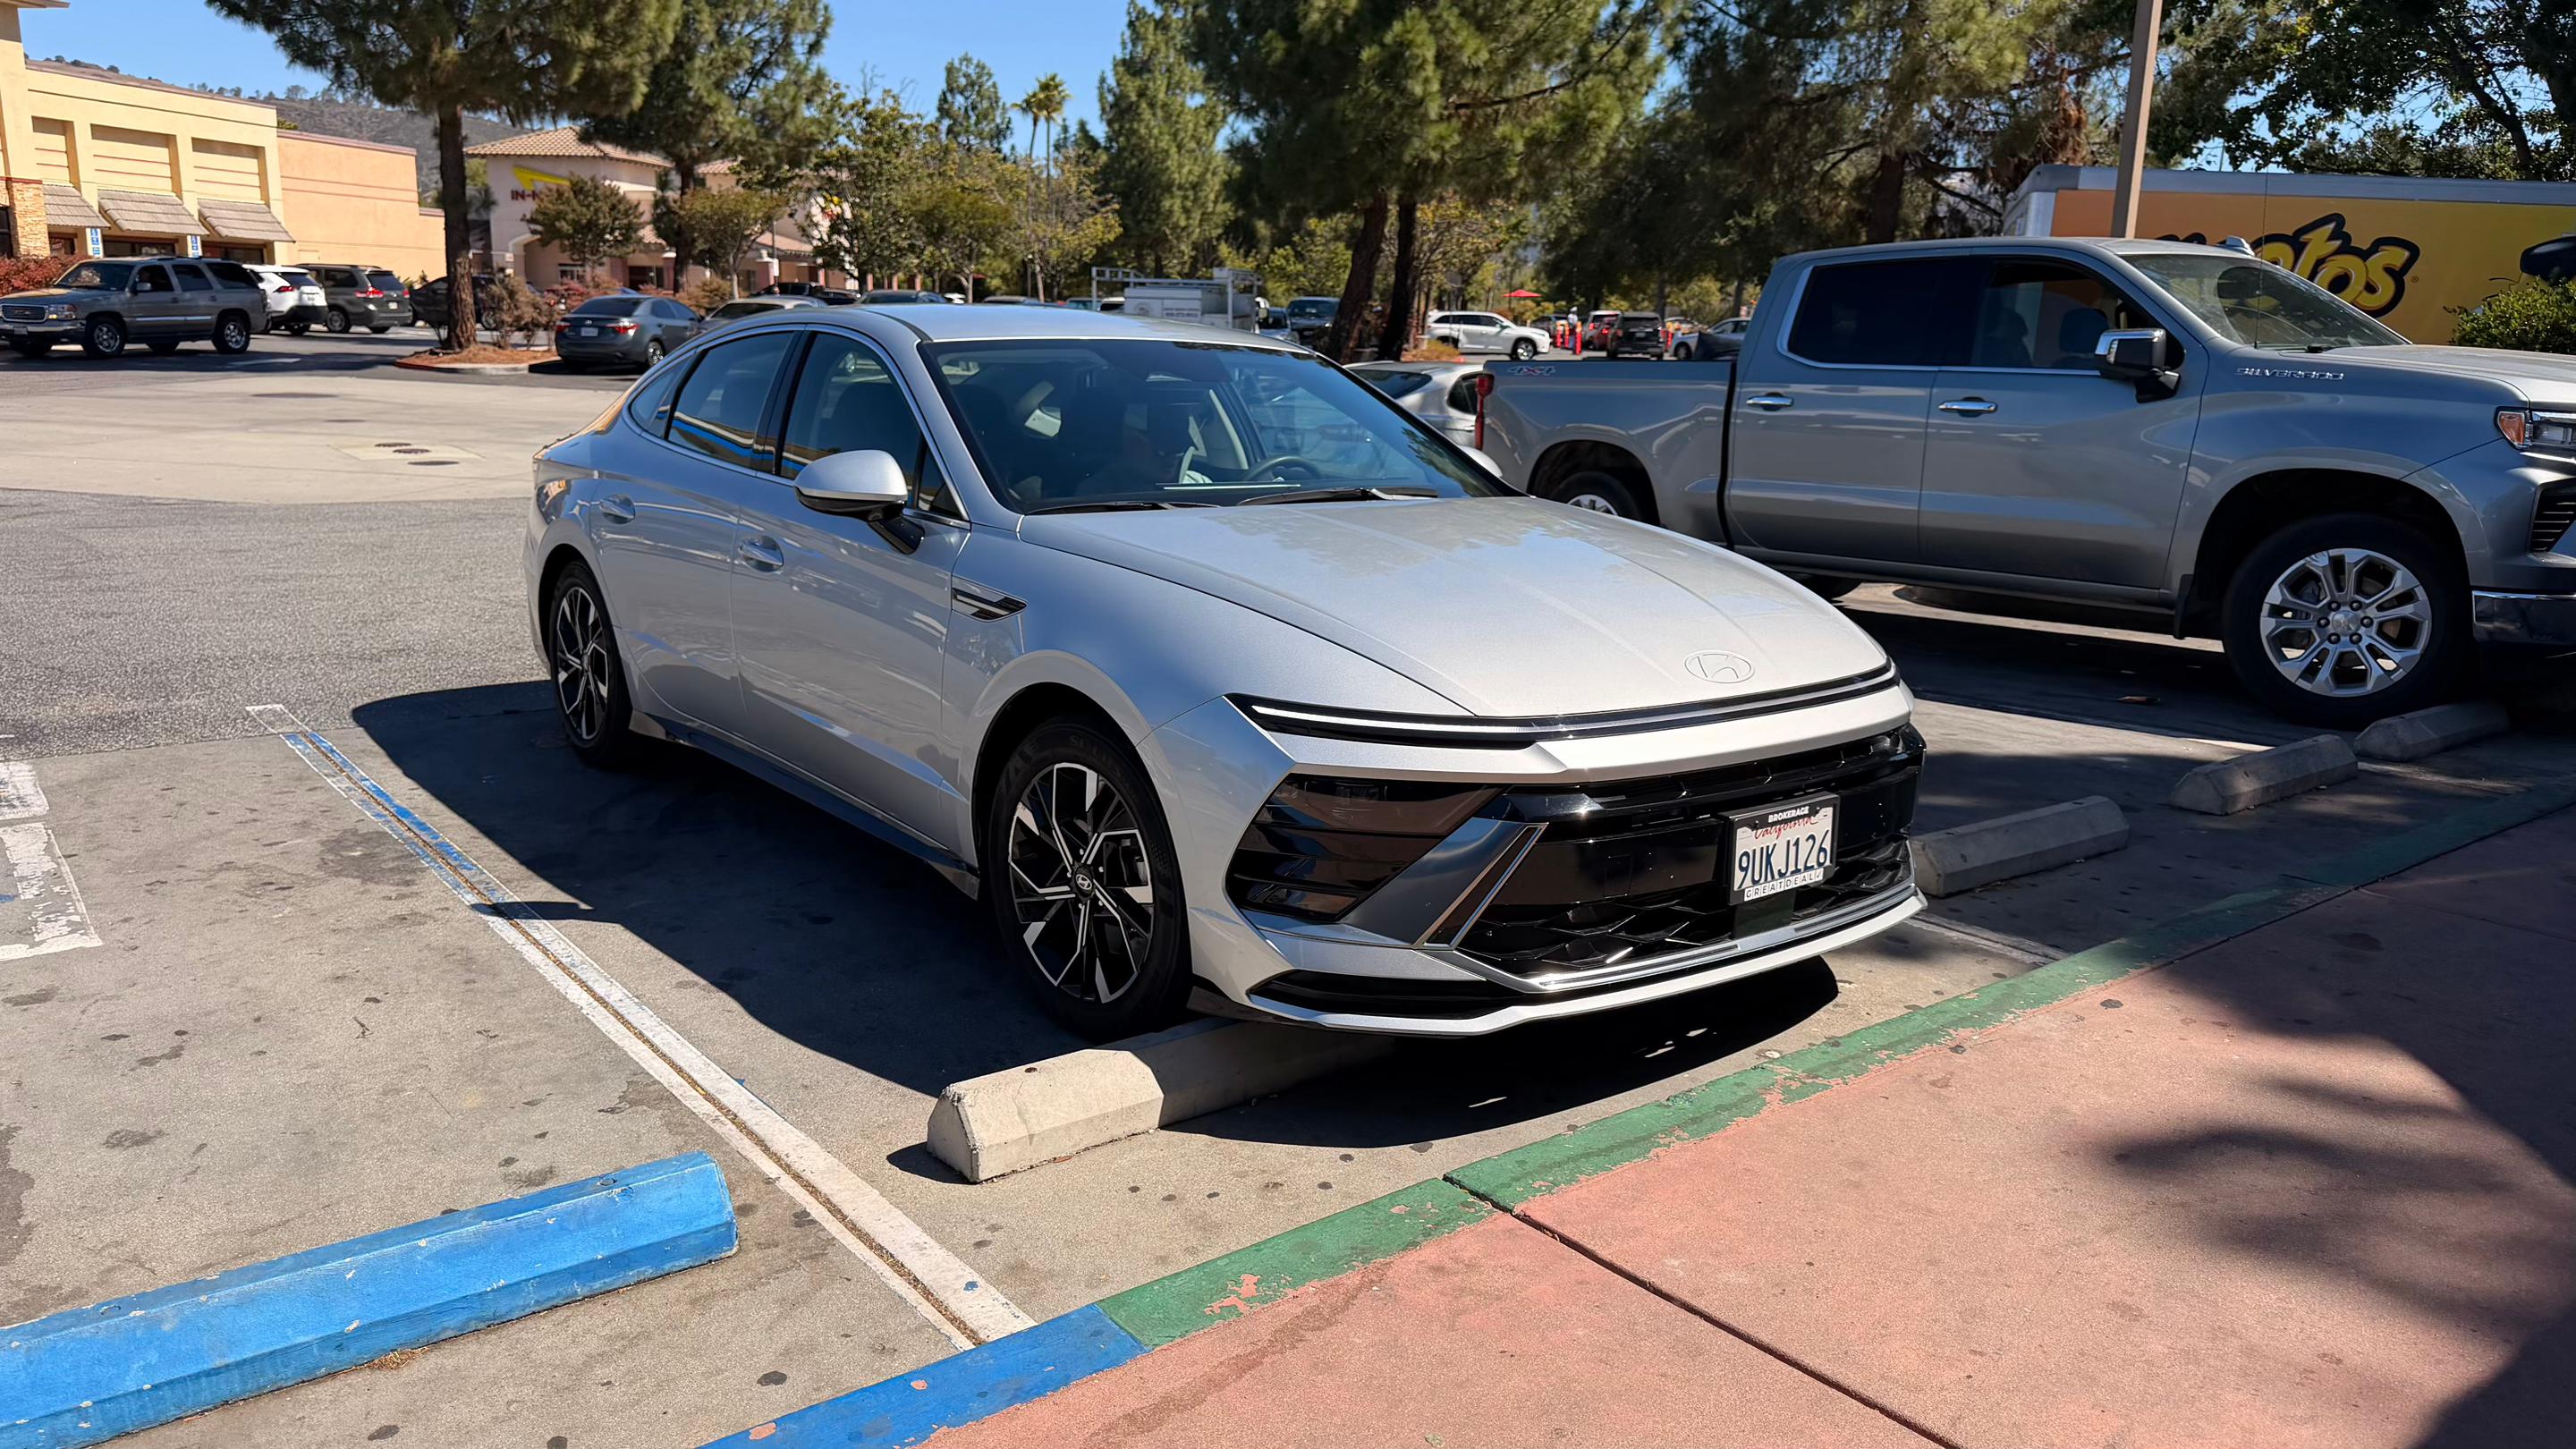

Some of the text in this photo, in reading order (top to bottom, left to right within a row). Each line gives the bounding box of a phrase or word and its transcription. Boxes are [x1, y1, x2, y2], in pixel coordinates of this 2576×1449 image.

[2236, 368, 2344, 381] SILVERADO
[1767, 806, 1809, 823] BROKERAGE
[1737, 829, 1829, 889] 9UKJ126
